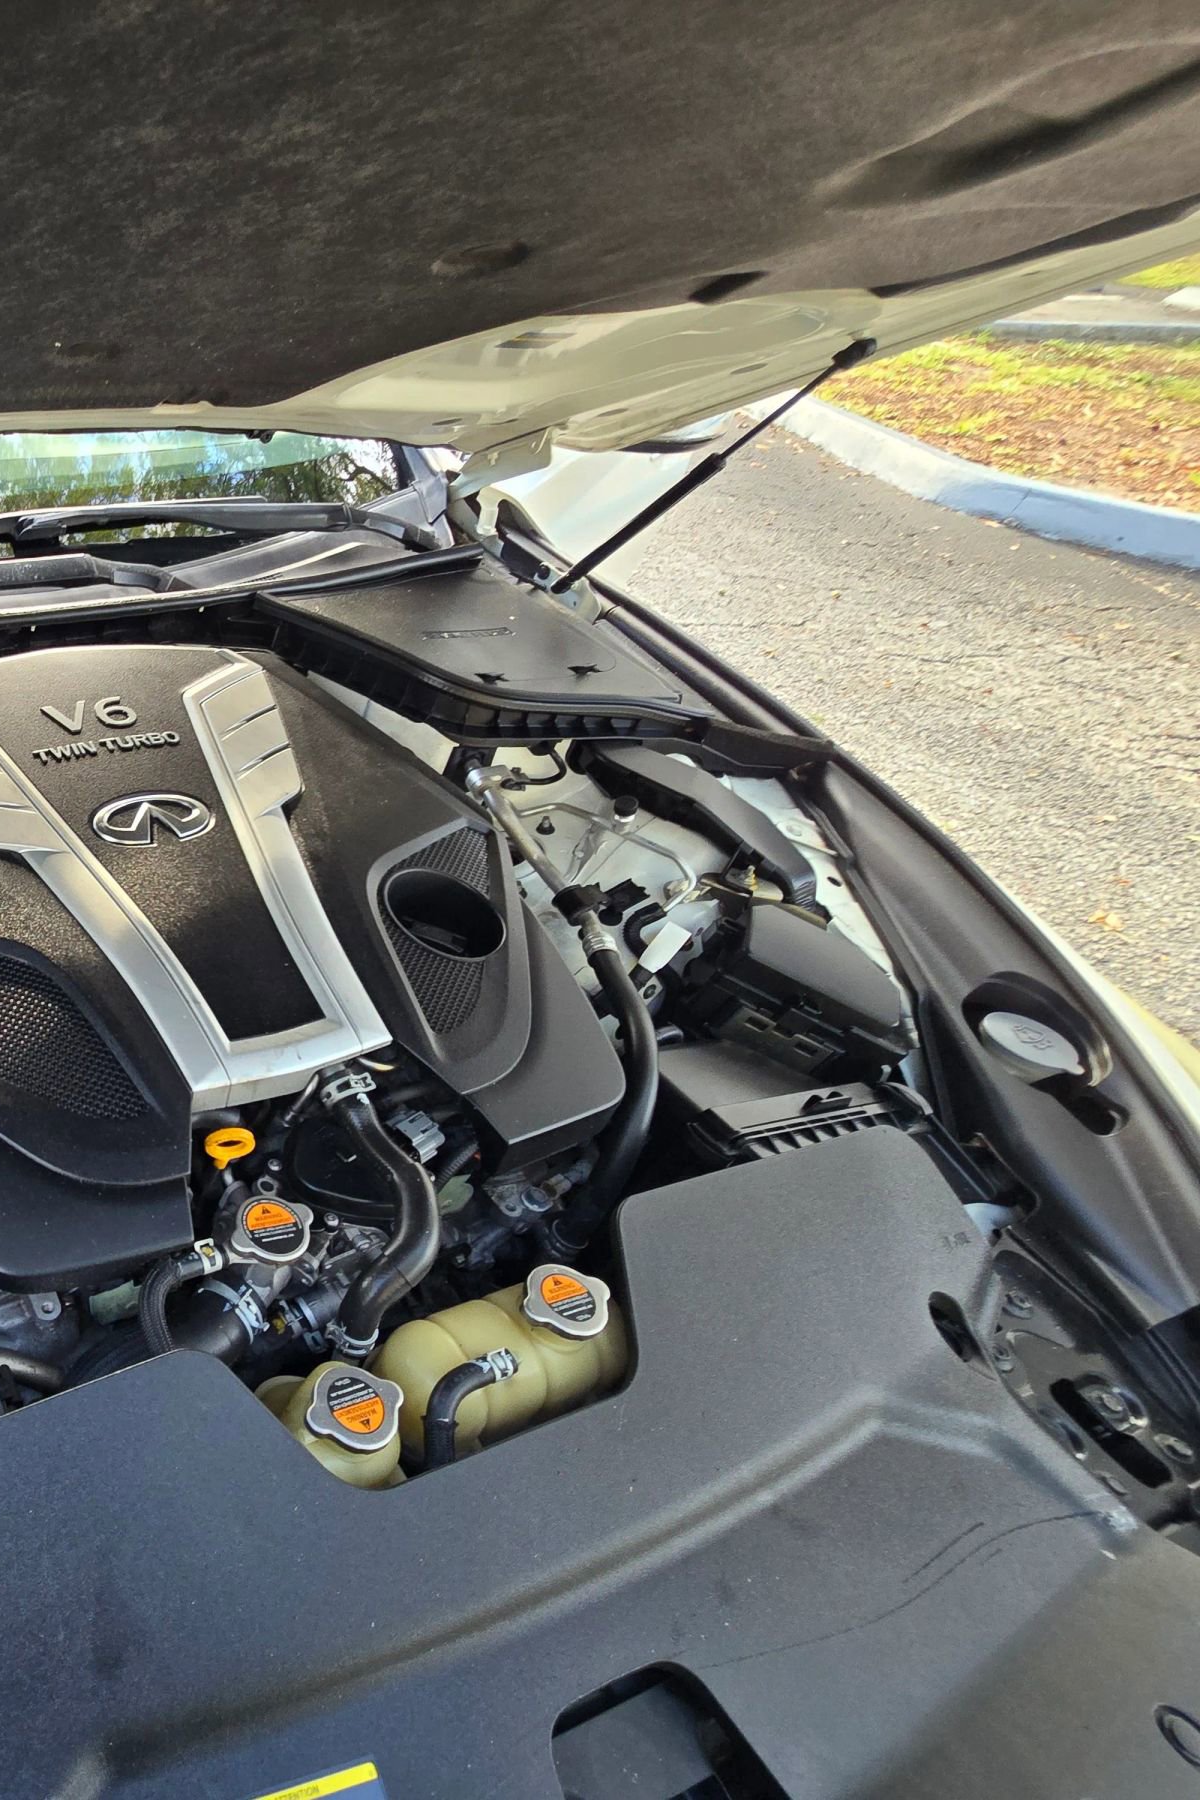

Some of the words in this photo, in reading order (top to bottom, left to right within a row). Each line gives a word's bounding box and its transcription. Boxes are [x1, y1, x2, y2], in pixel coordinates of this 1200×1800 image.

[40, 696, 137, 734] V6
[32, 740, 98, 765] TWIN
[98, 731, 180, 753] TURBO
